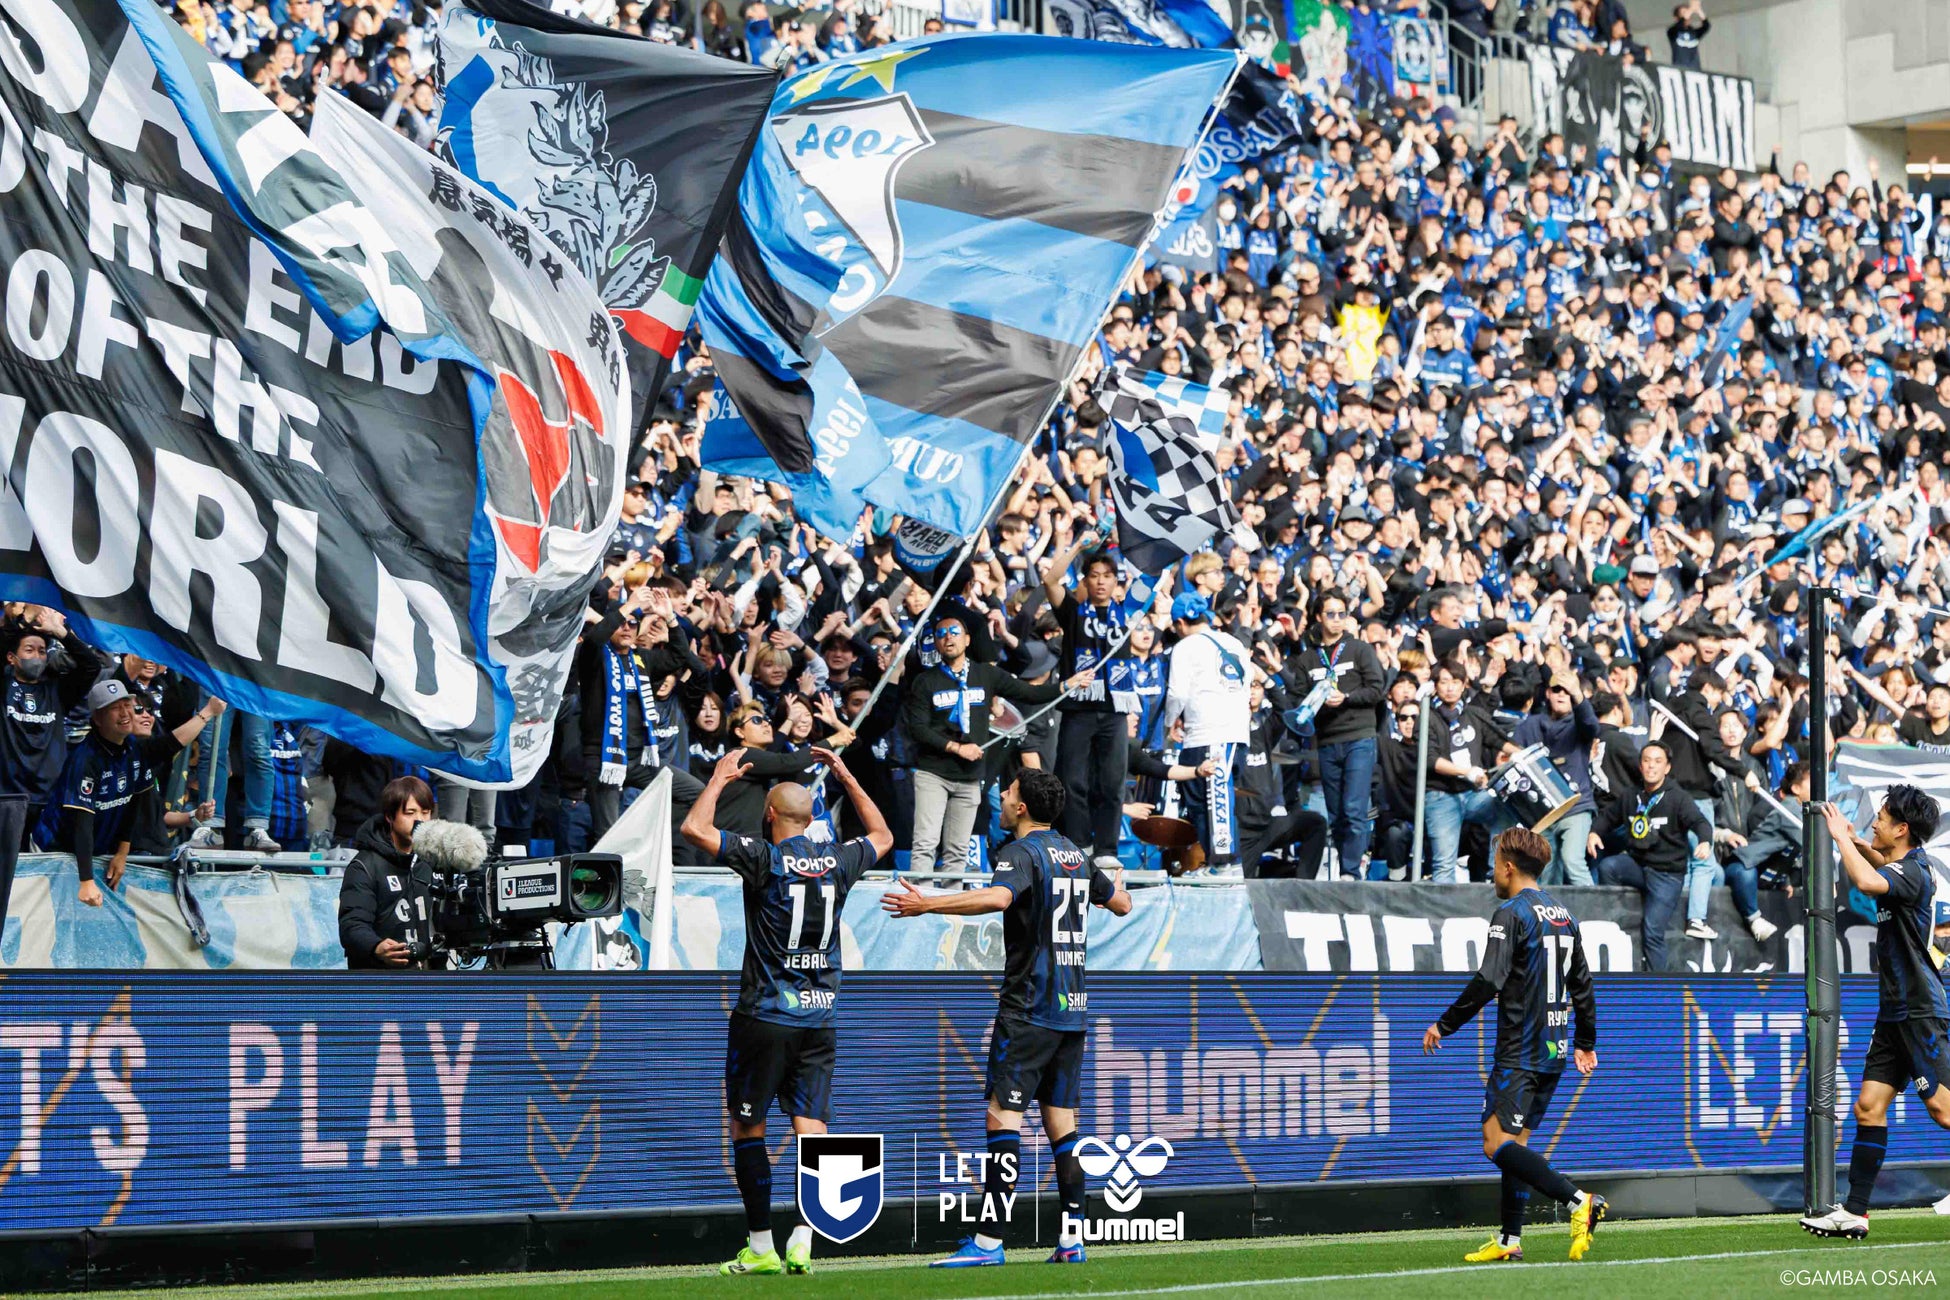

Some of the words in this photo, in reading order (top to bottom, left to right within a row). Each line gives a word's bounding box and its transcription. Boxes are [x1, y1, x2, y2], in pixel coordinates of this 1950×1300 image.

[33, 126, 213, 308] THE
[6, 248, 139, 381] OF
[146, 316, 329, 480] THE
[782, 855, 837, 874] ROHTO
[788, 884, 836, 950] 11
[1052, 877, 1091, 944] 23
[800, 990, 836, 1004] SHIP
[1543, 934, 1574, 1003] 17
[229, 1019, 481, 1172] PLAY
[1094, 1012, 1391, 1140] hummel
